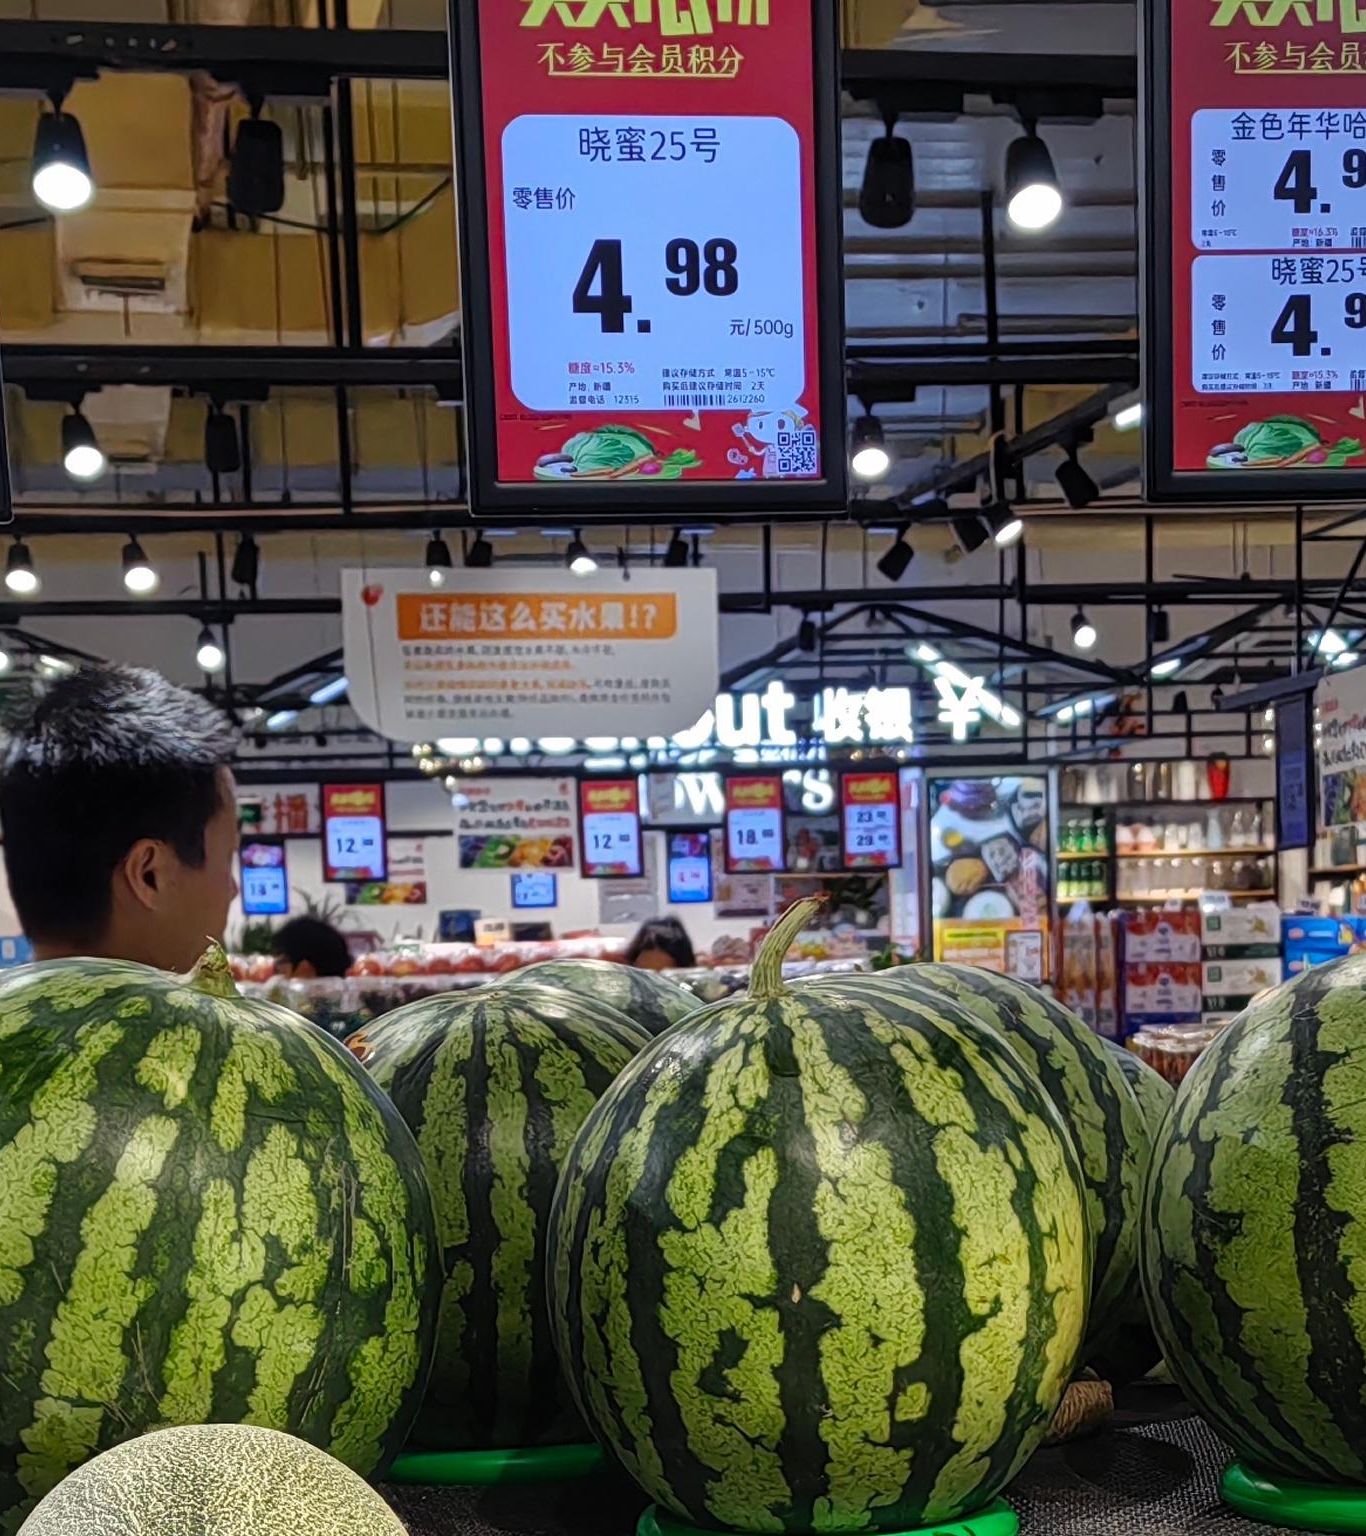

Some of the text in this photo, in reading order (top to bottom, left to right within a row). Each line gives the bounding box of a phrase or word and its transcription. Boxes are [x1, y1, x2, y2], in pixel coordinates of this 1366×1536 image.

[536, 42, 745, 76] 不参与会员积分
[579, 126, 722, 164] 晓蜜25号
[512, 187, 577, 211] 零售价
[1211, 149, 1226, 217] 零售价
[729, 318, 795, 339] 元/500g
[1211, 294, 1226, 361] 零售价
